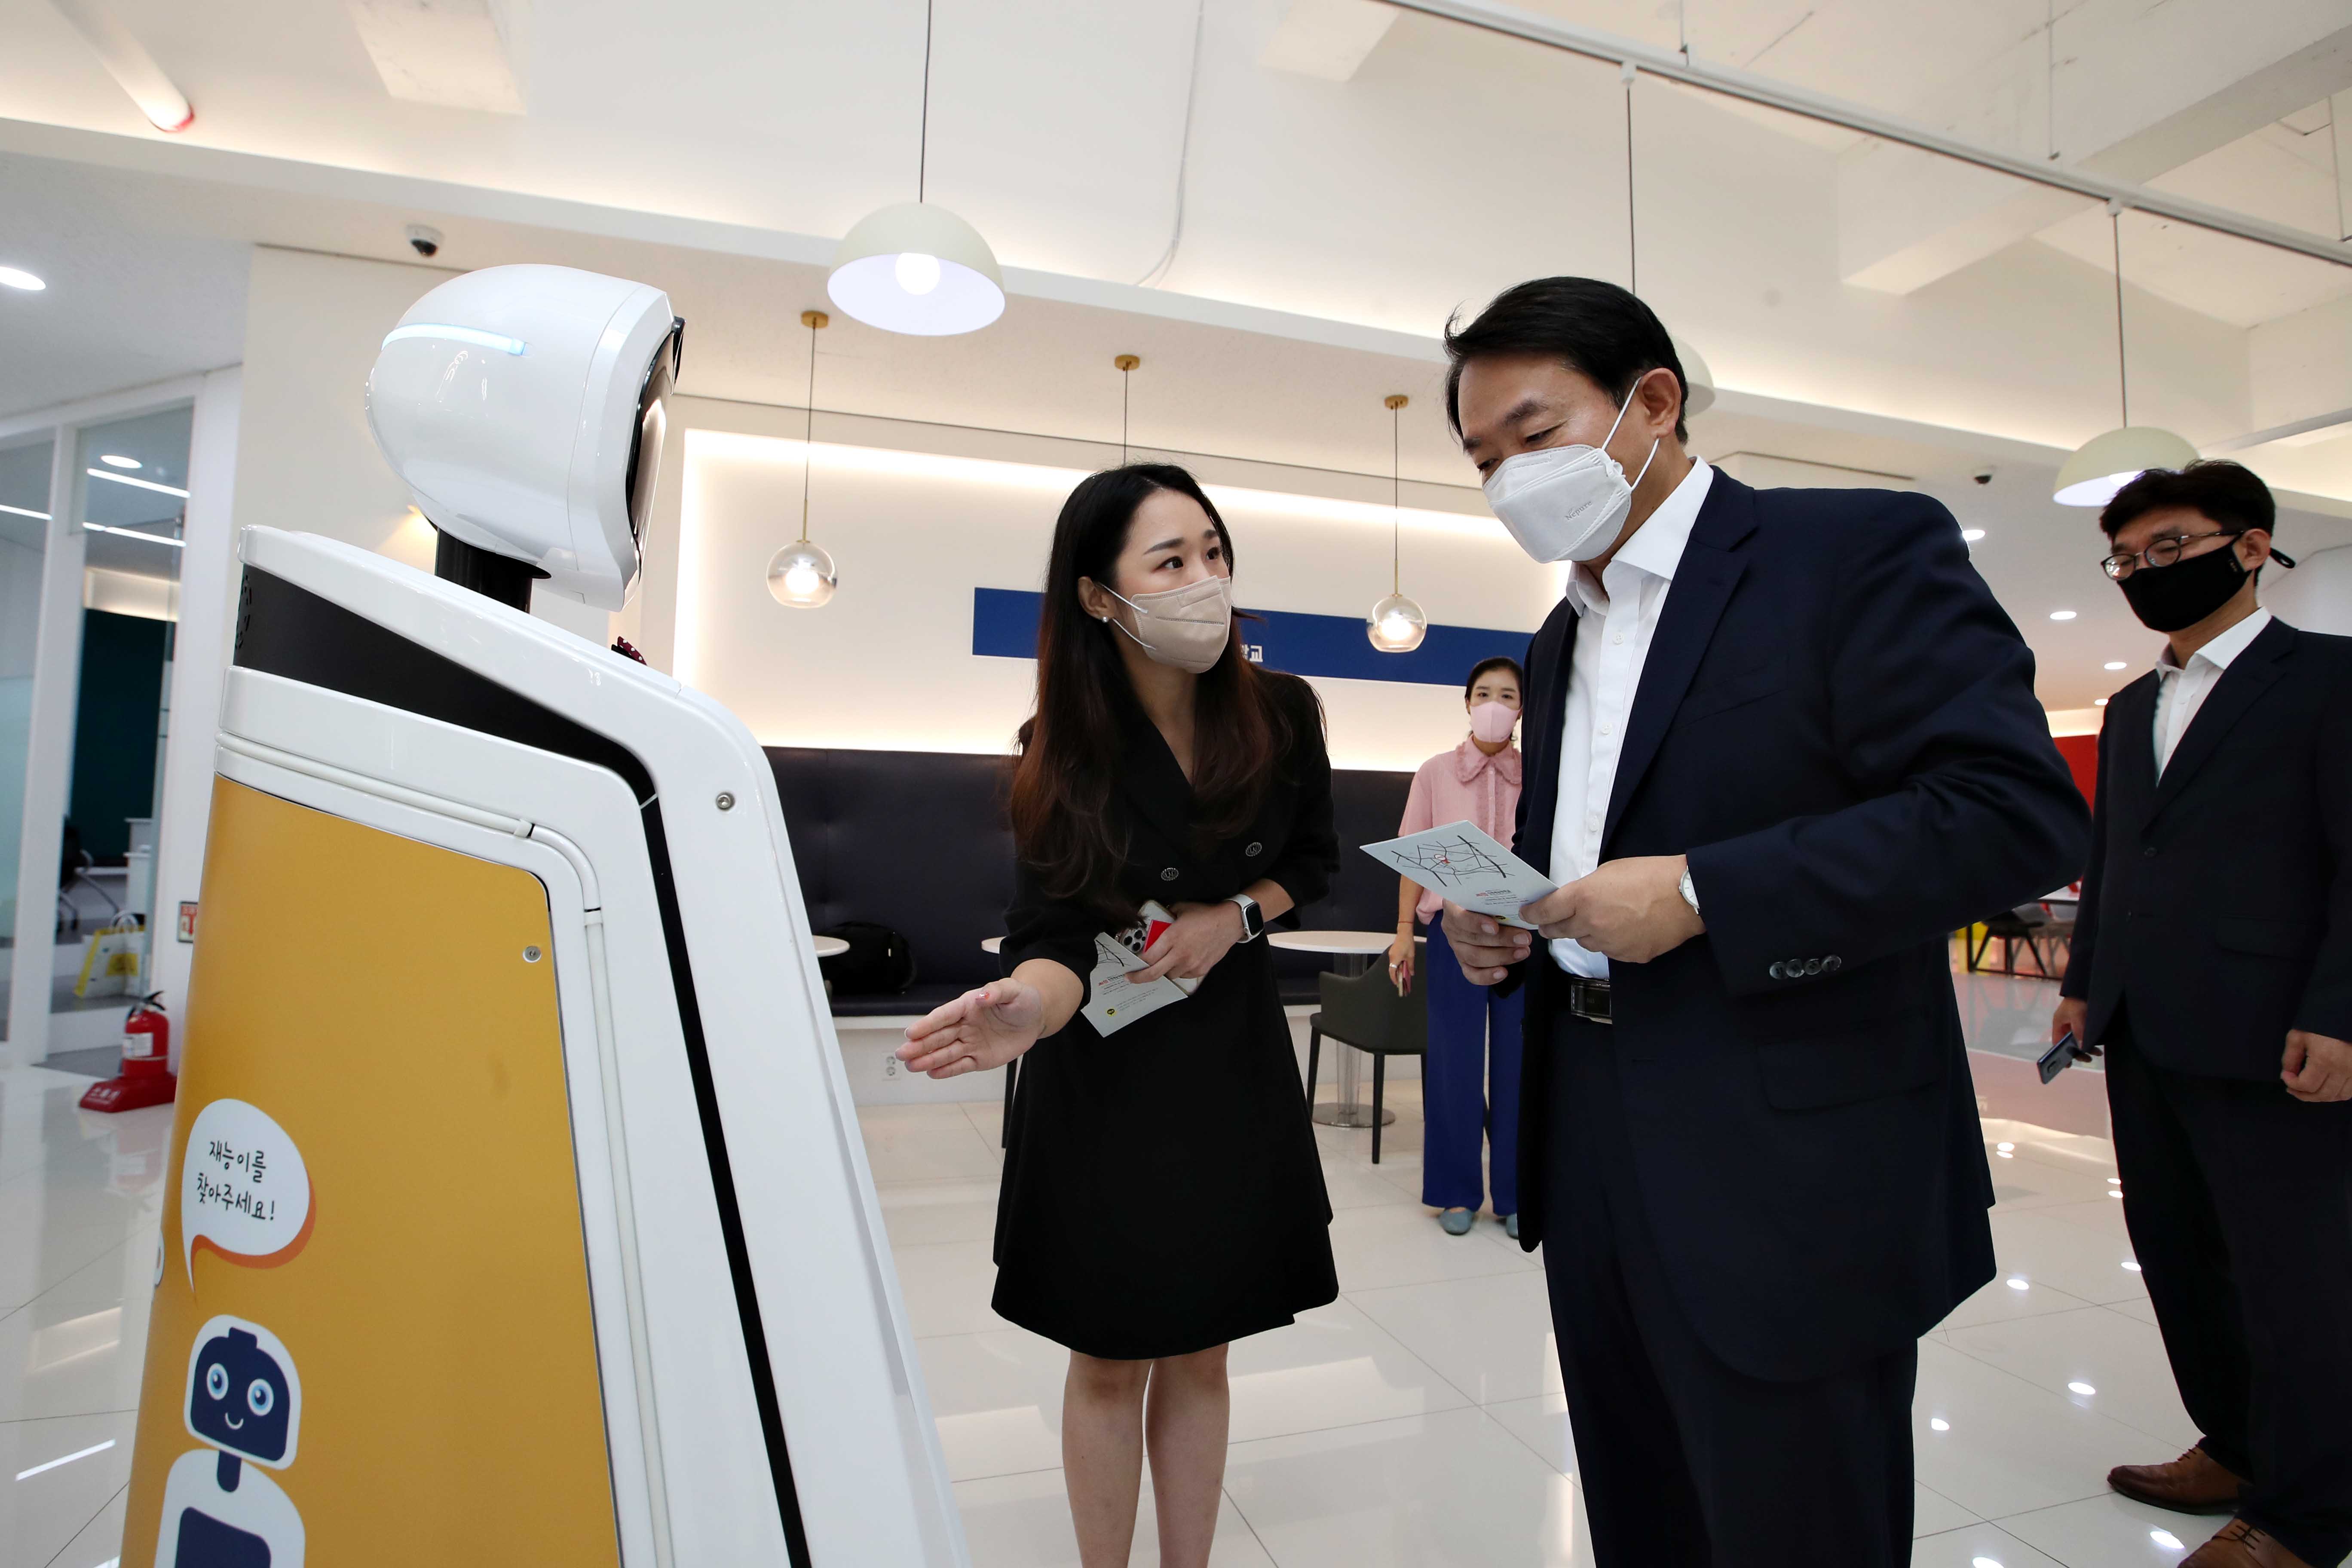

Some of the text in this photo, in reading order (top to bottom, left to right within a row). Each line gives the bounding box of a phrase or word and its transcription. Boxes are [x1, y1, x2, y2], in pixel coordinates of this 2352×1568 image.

[1565, 501, 1592, 520] Nepure
[209, 1140, 266, 1183] 재능이를
[197, 1172, 274, 1221] 찾아주세요!
